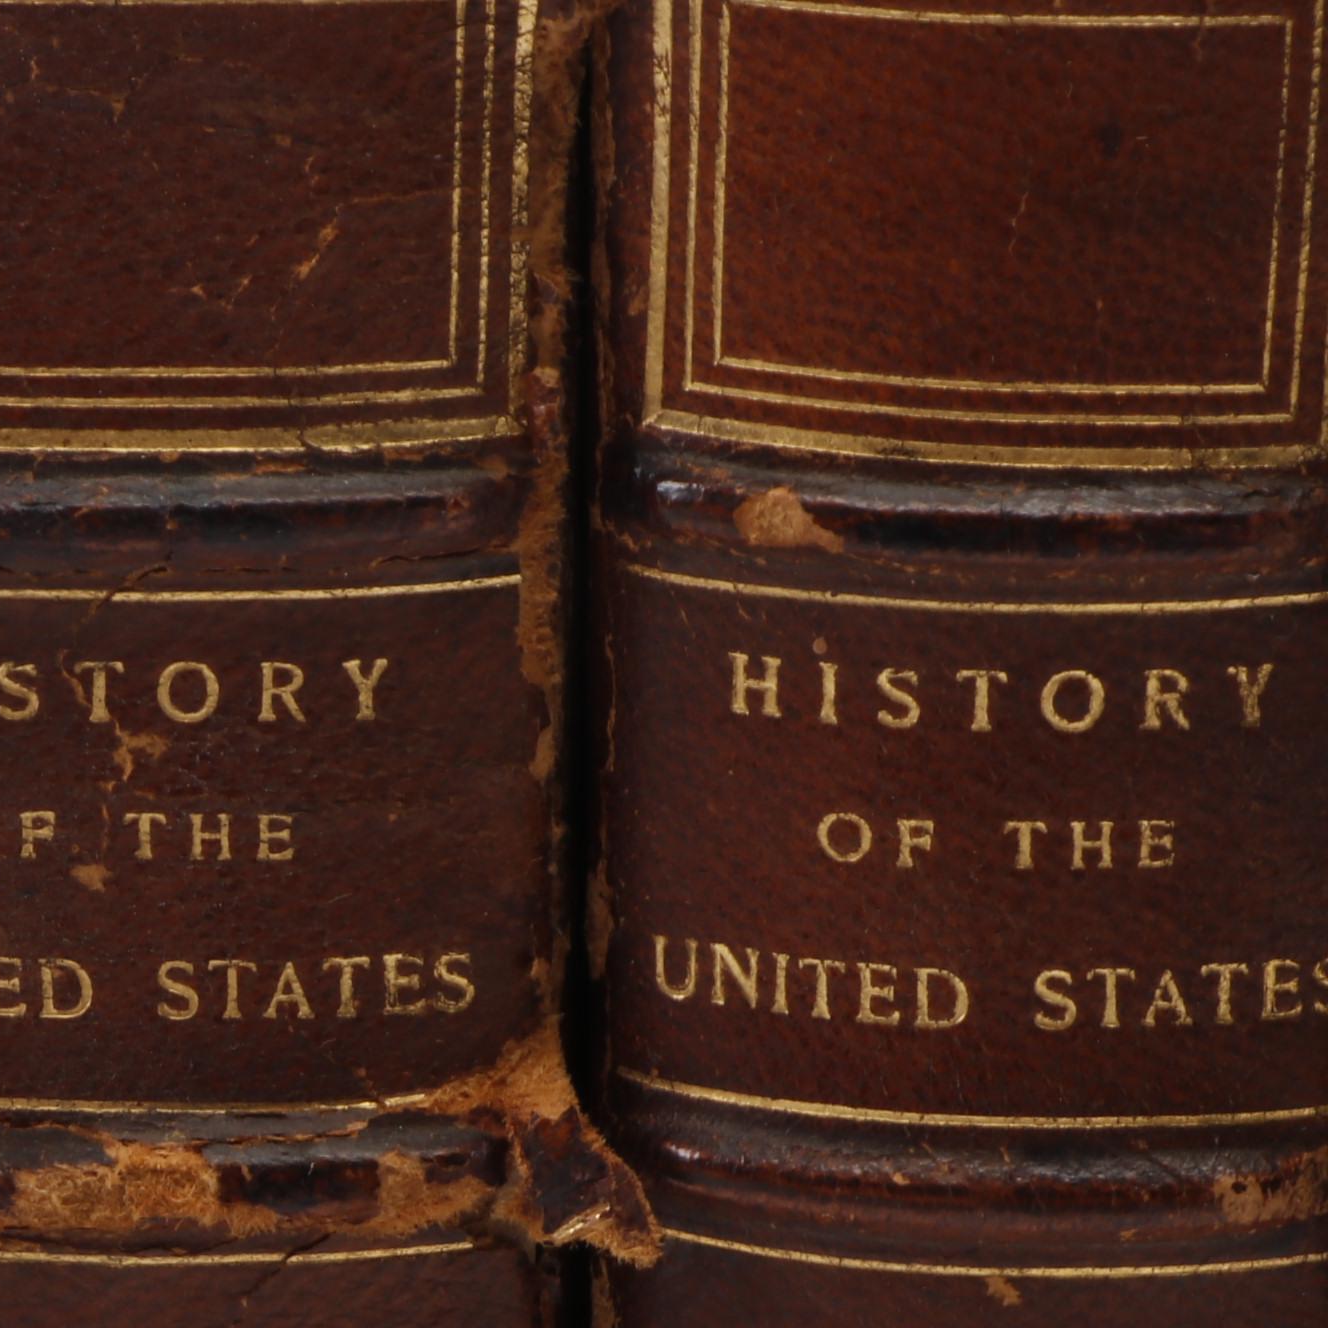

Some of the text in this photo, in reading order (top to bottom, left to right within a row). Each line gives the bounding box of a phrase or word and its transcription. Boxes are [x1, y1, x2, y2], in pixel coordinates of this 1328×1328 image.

[727, 651, 1273, 732] HISTORY
[124, 811, 294, 861] THE
[816, 811, 1175, 870] OF THE
[157, 951, 475, 1022] STATES
[654, 934, 970, 1029] UNITED
